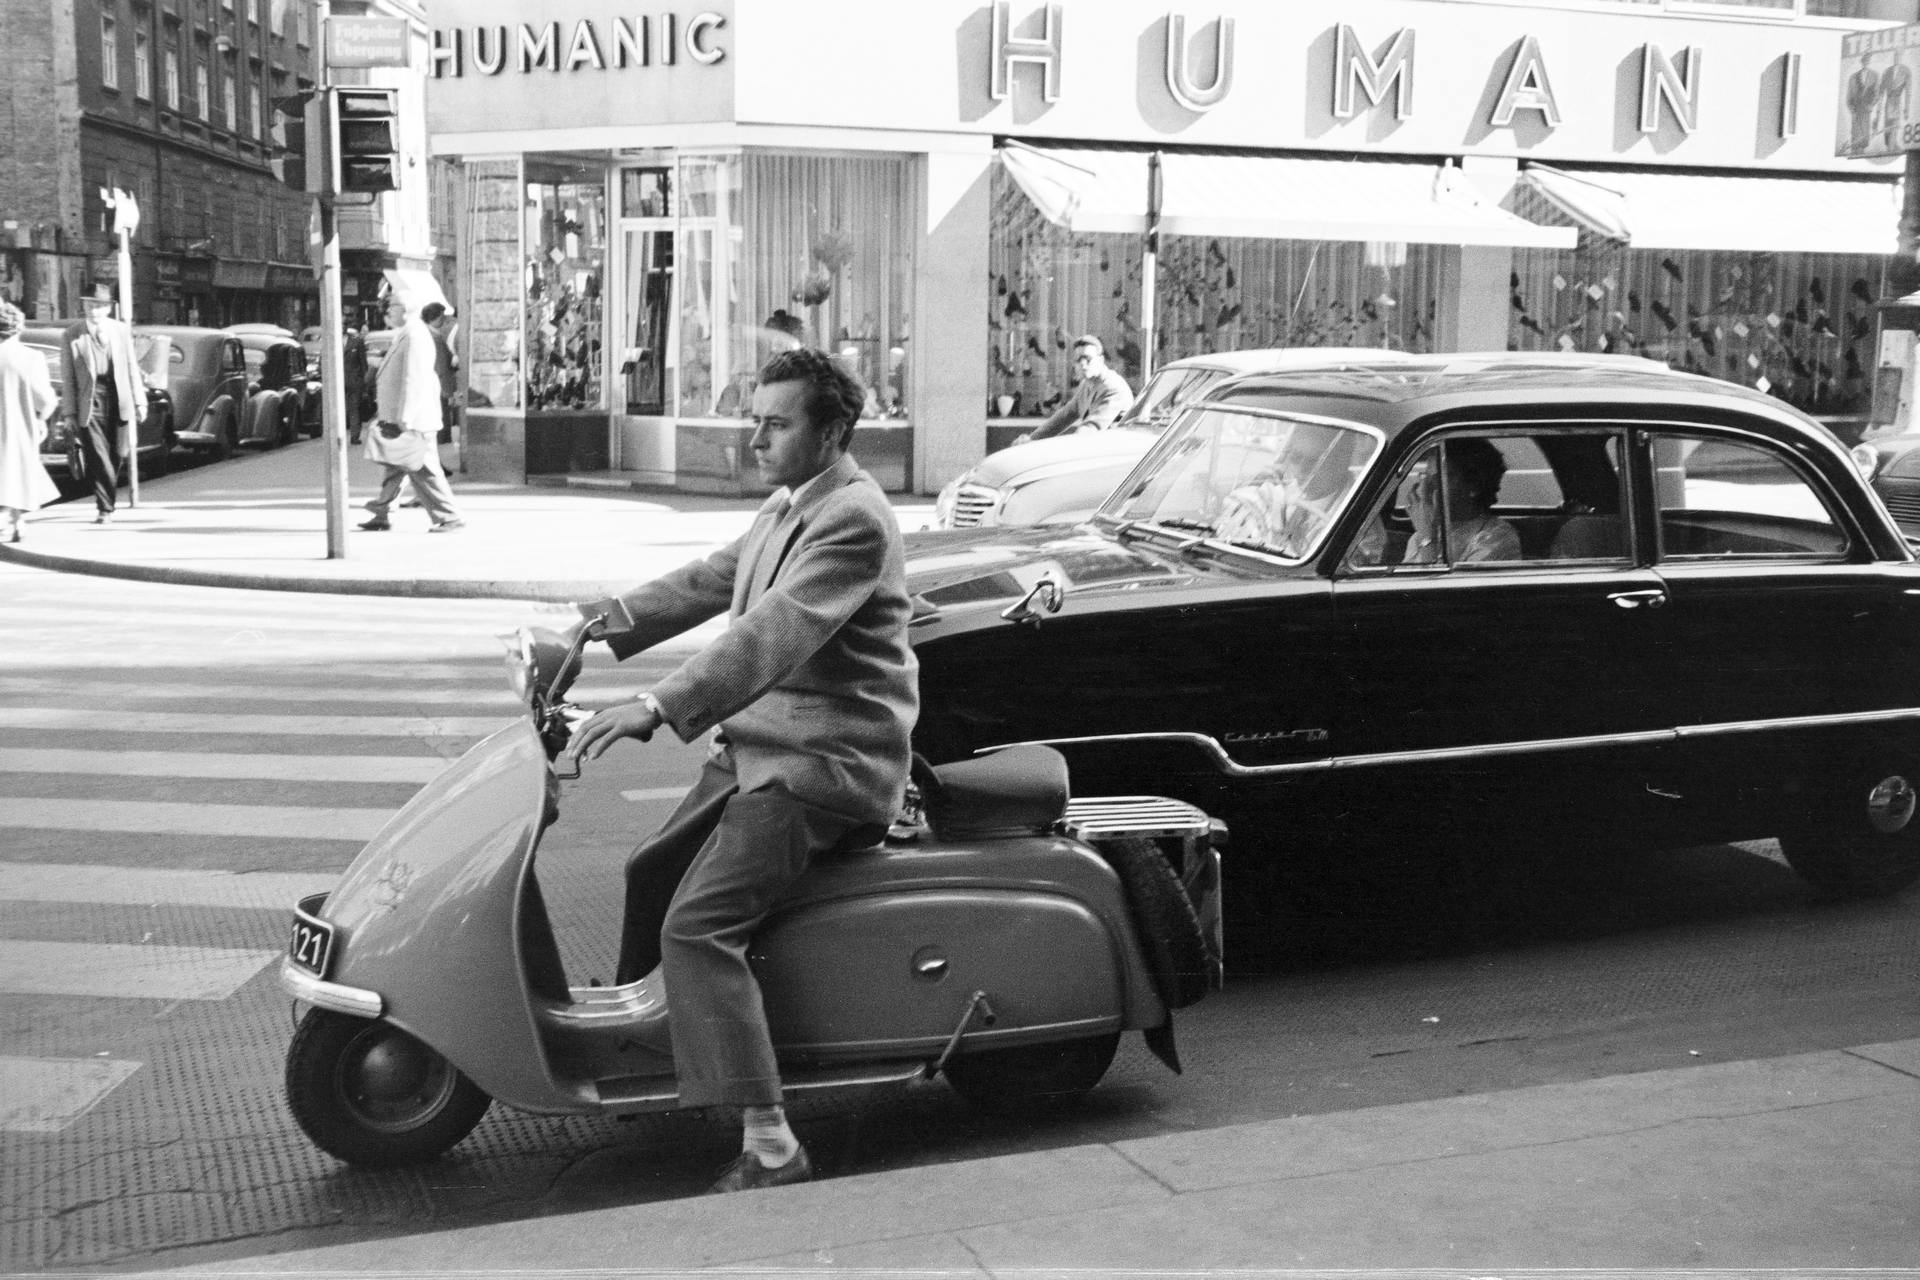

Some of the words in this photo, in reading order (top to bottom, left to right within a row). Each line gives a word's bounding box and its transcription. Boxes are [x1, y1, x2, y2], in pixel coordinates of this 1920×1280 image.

[334, 39, 402, 60] Übergang
[428, 12, 727, 79] HUMANIC
[990, 0, 1801, 138] HUMANI
[292, 923, 323, 967] 121
